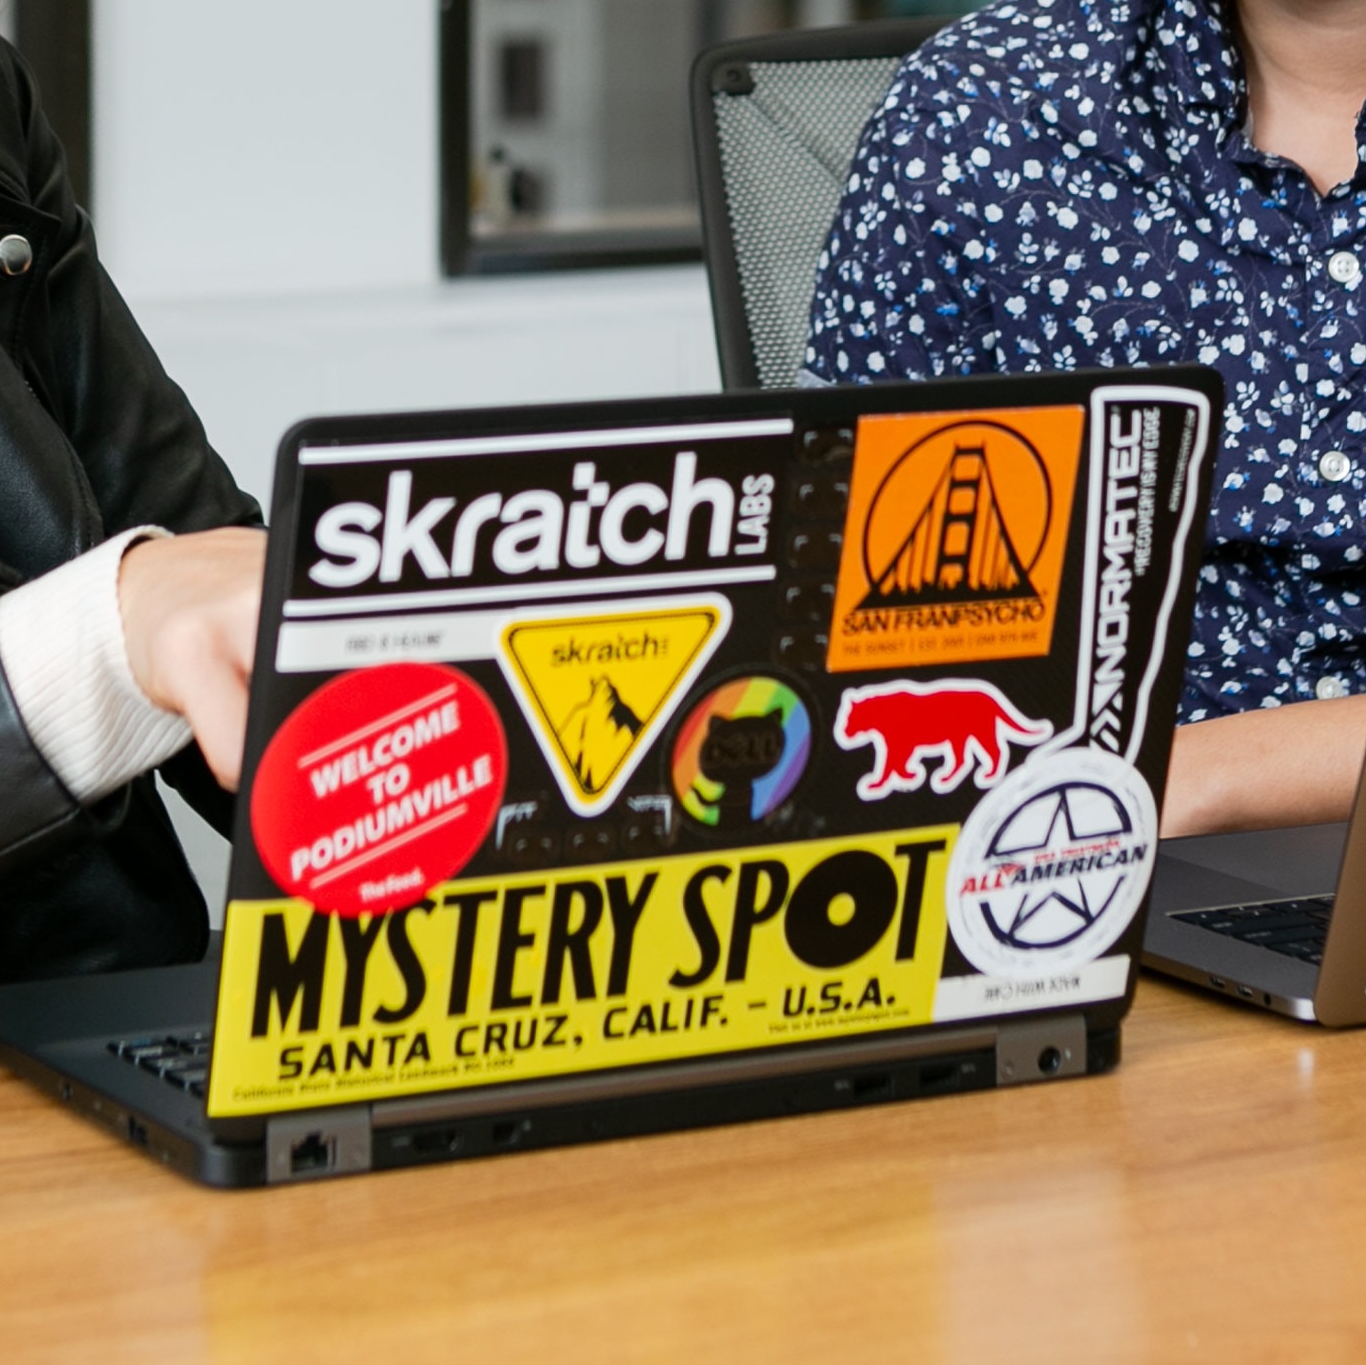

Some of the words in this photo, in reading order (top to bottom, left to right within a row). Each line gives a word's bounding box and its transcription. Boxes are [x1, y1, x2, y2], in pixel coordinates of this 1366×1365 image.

[308, 451, 735, 588] skratch
[735, 473, 774, 555] LABS
[1095, 410, 1141, 683] NORMATEC
[552, 633, 659, 665] skratch
[842, 609, 887, 636] SAN
[309, 701, 461, 801] WELCOME
[366, 764, 412, 805] TO
[290, 756, 493, 883] PODIUMVILLE
[959, 872, 1005, 898] ALL
[1010, 844, 1148, 887] AMERICAN
[251, 872, 659, 1039] MYSTERY
[669, 840, 946, 989] SPOT
[278, 1034, 431, 1082] SANTA
[456, 1016, 583, 1058] CRUZ,
[602, 998, 729, 1040] CALIF.
[782, 978, 896, 1019] U.S.A.
